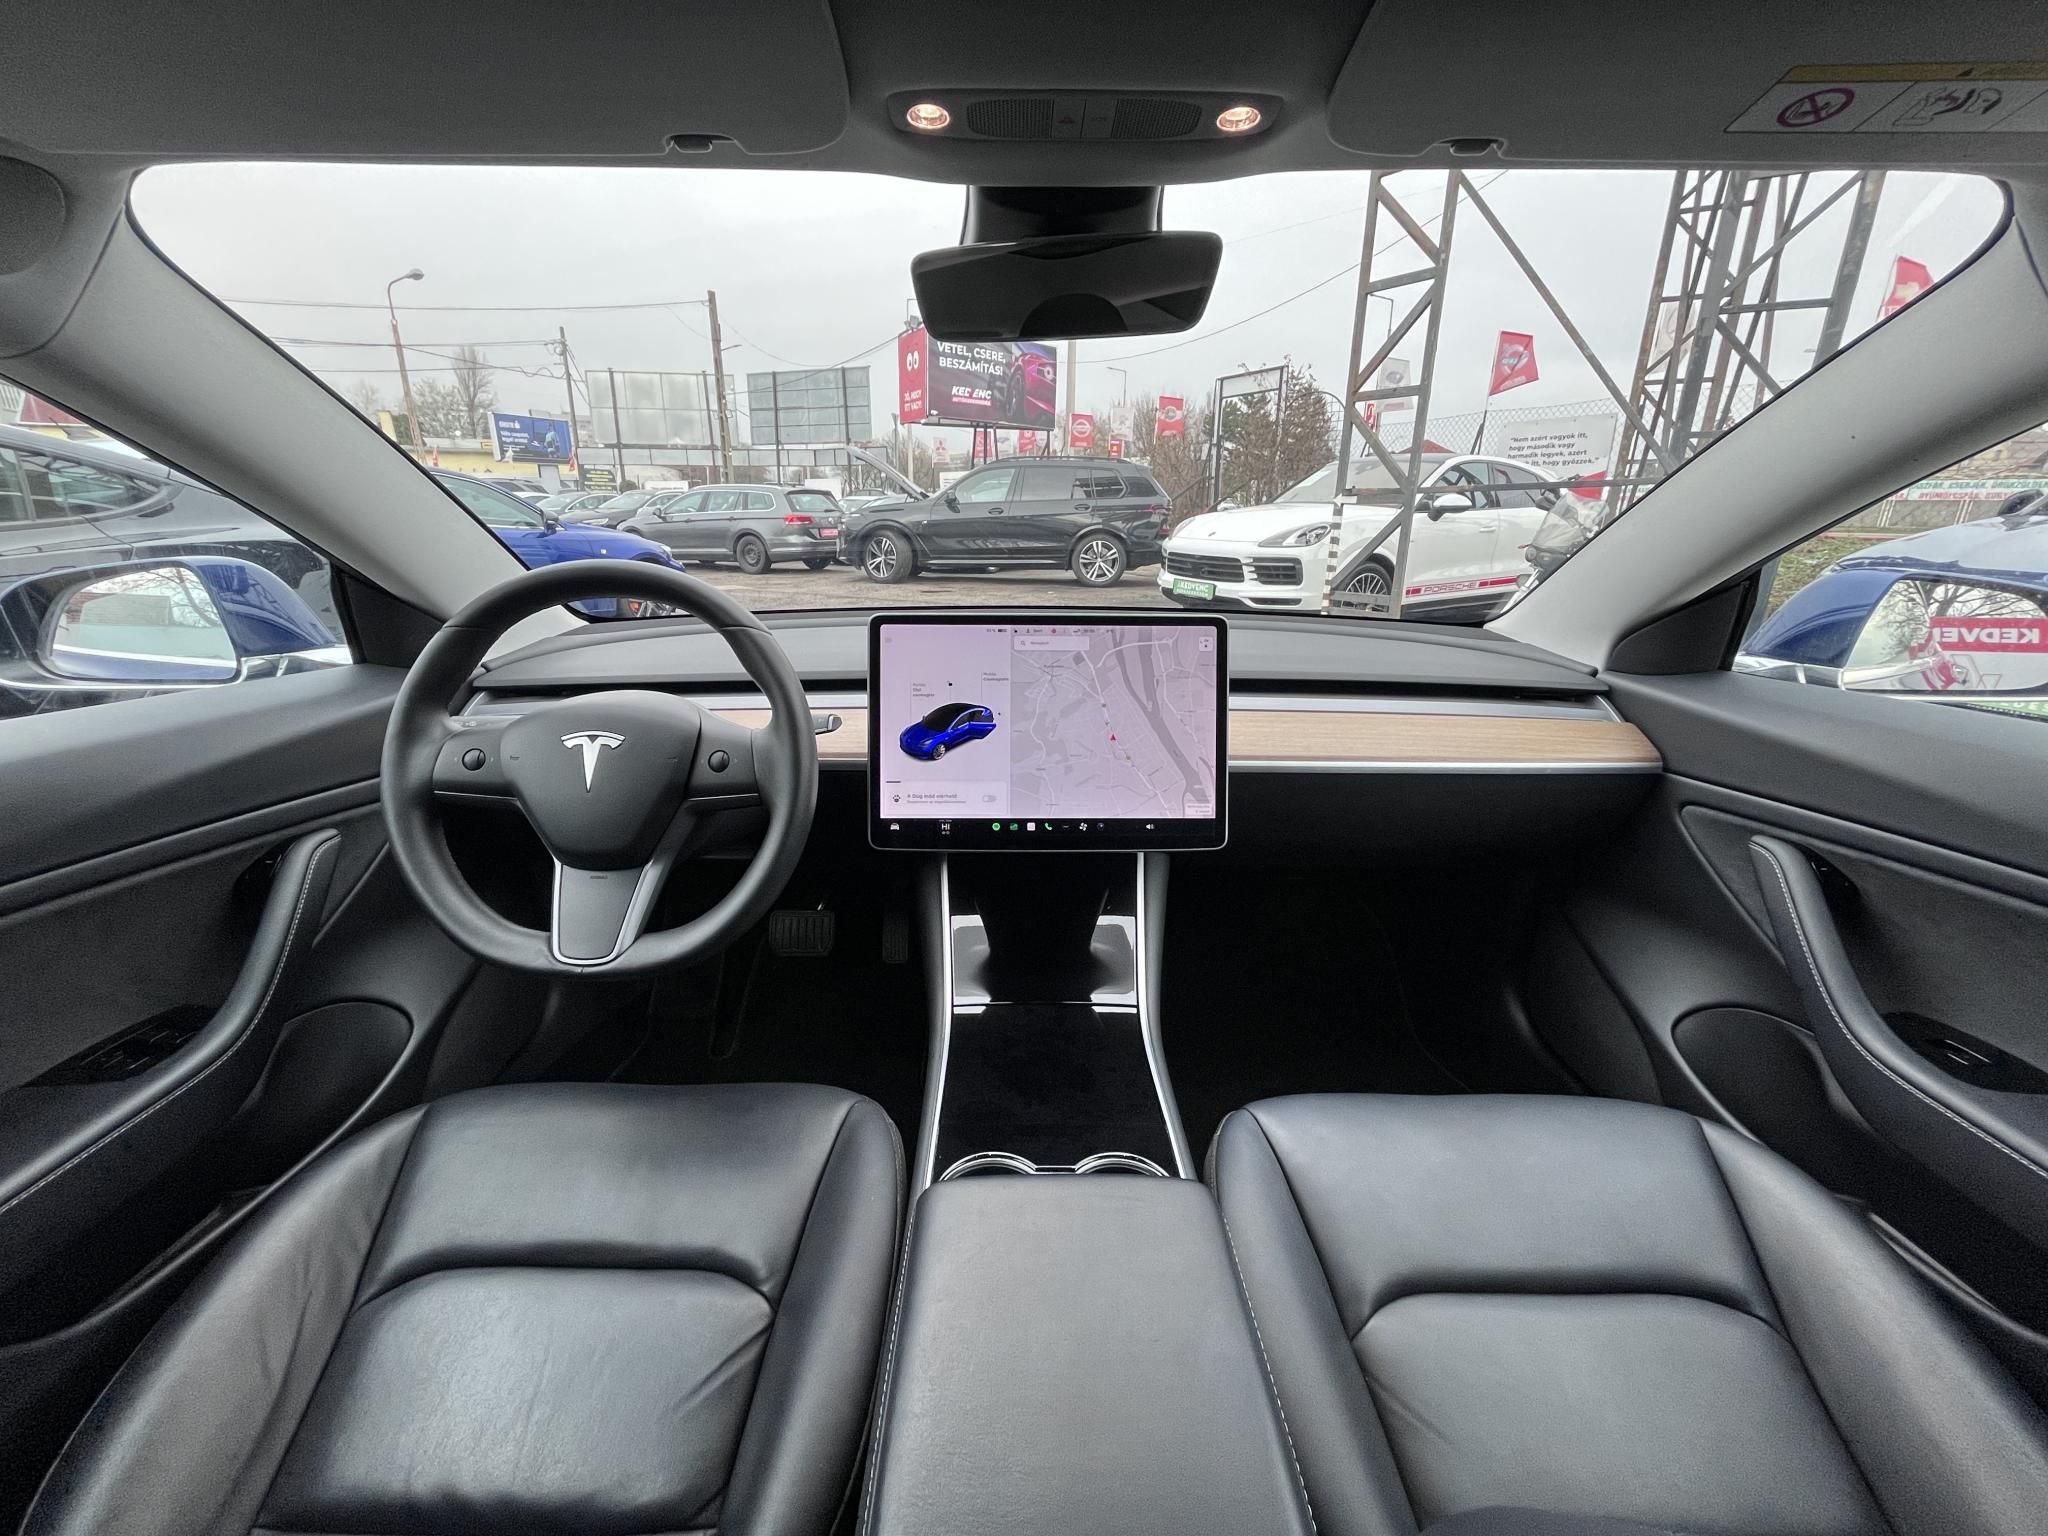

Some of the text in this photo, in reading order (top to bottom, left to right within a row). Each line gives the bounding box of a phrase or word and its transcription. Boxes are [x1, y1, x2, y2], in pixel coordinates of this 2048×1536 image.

[974, 348, 1006, 364] CSERE,
[939, 355, 1003, 376] BESZÁMÍTÁS!
[1549, 432, 1576, 442] vagyok
[1507, 451, 1538, 459] harmadik
[1424, 582, 1477, 593] PORSCHE
